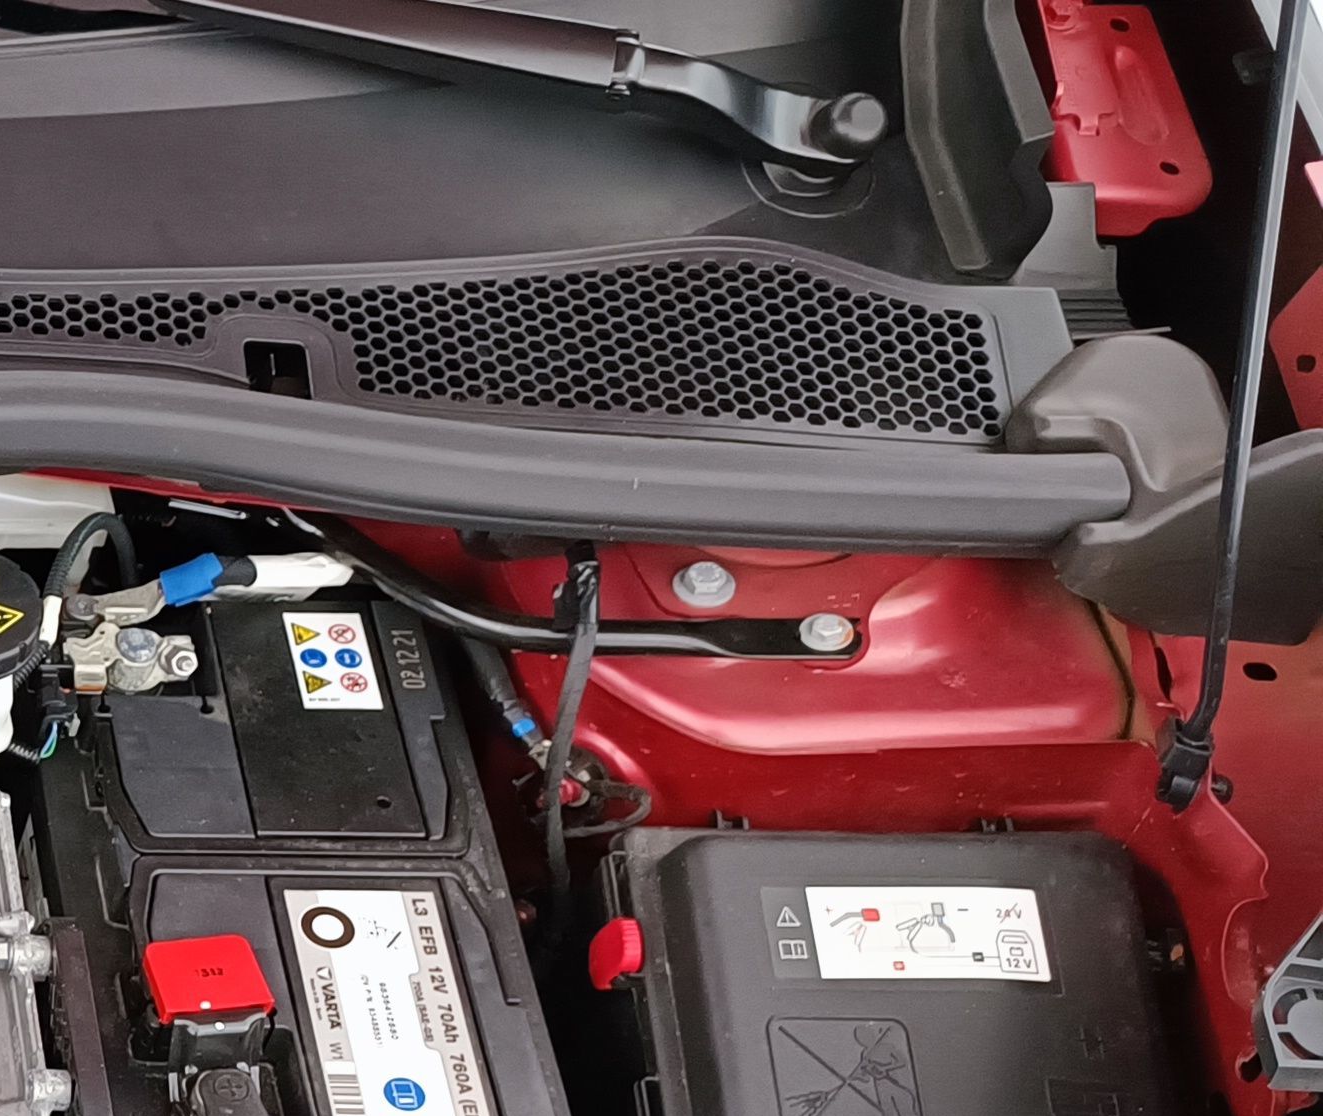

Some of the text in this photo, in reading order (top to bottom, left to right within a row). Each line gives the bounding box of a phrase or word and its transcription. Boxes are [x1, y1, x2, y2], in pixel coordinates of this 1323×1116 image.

[390, 630, 426, 689] 02.12.21
[411, 898, 429, 917] L3
[419, 926, 438, 956] EFB
[1006, 958, 1032, 969] 12 V
[429, 967, 449, 995] 12V
[322, 984, 343, 1030] VARTA
[437, 1004, 458, 1043] 70Ah
[450, 1053, 473, 1095] 760A
